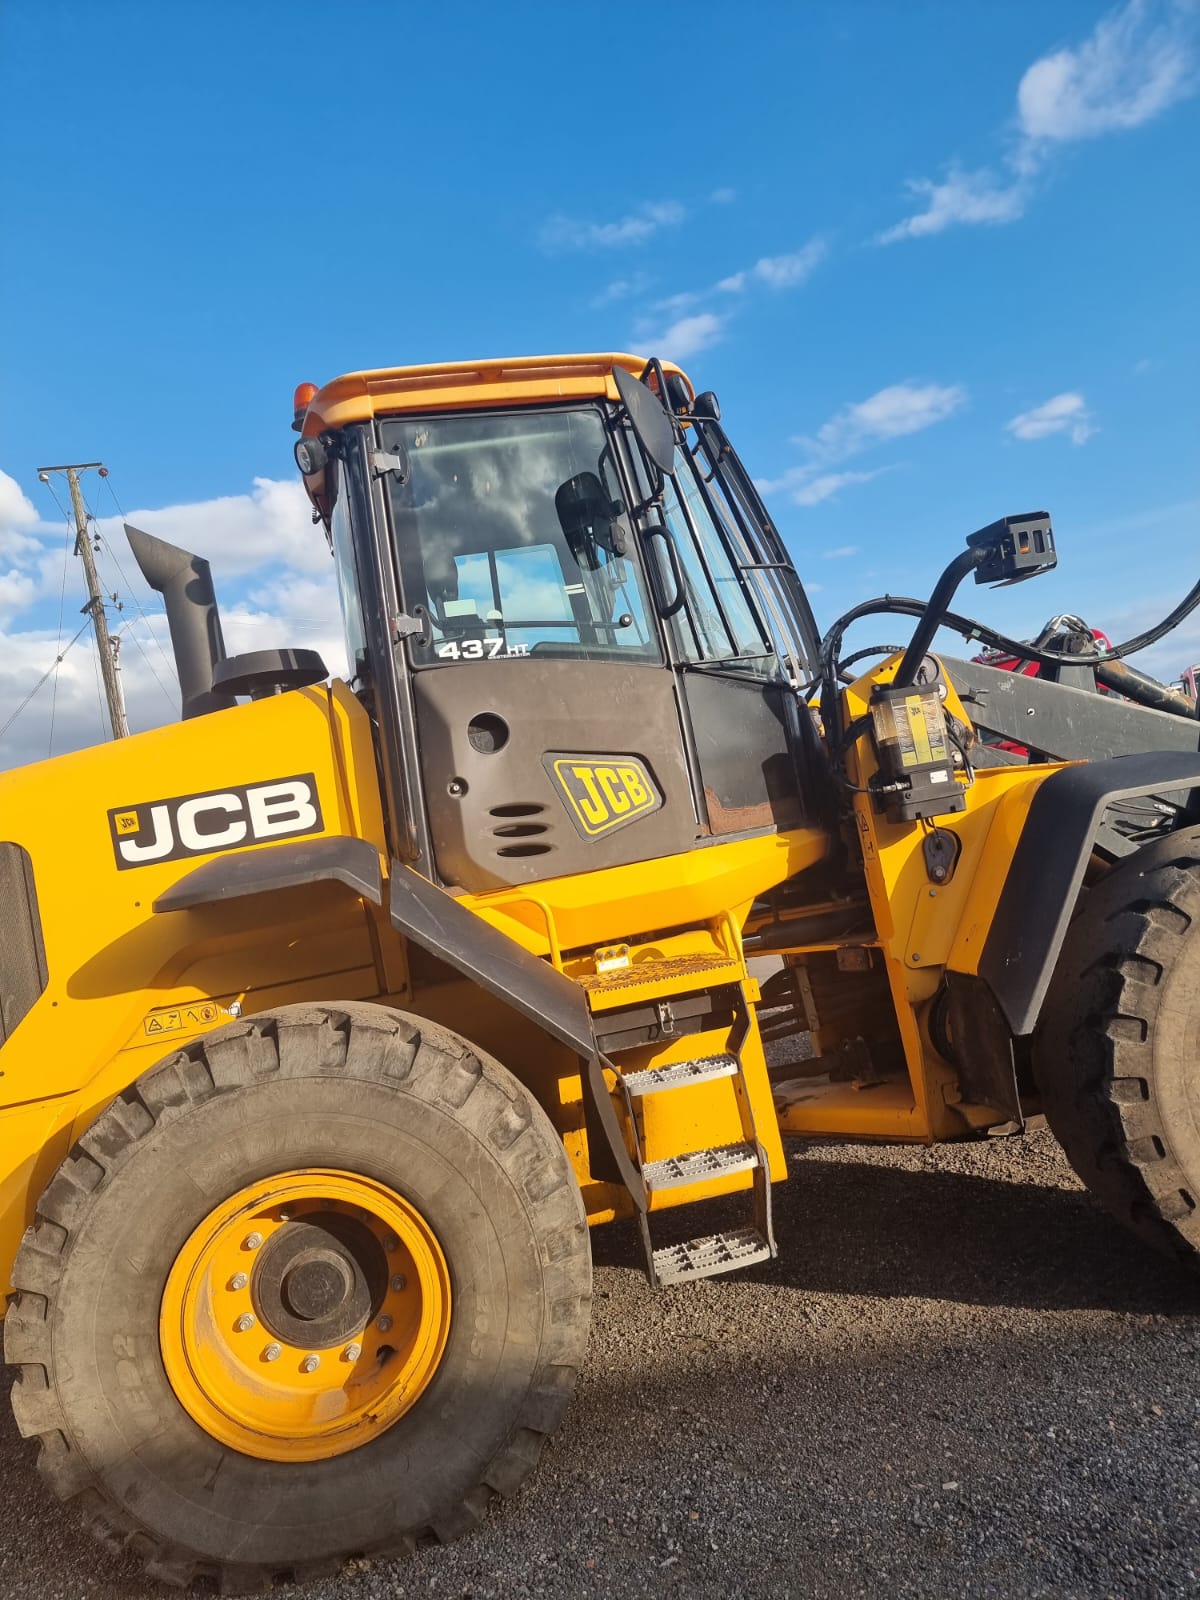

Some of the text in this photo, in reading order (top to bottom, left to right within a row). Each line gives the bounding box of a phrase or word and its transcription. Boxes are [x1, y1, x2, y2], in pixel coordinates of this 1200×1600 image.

[438, 638, 504, 659] 437
[507, 644, 529, 655] HT
[119, 781, 317, 862] JCB
[572, 767, 648, 825] JCB
